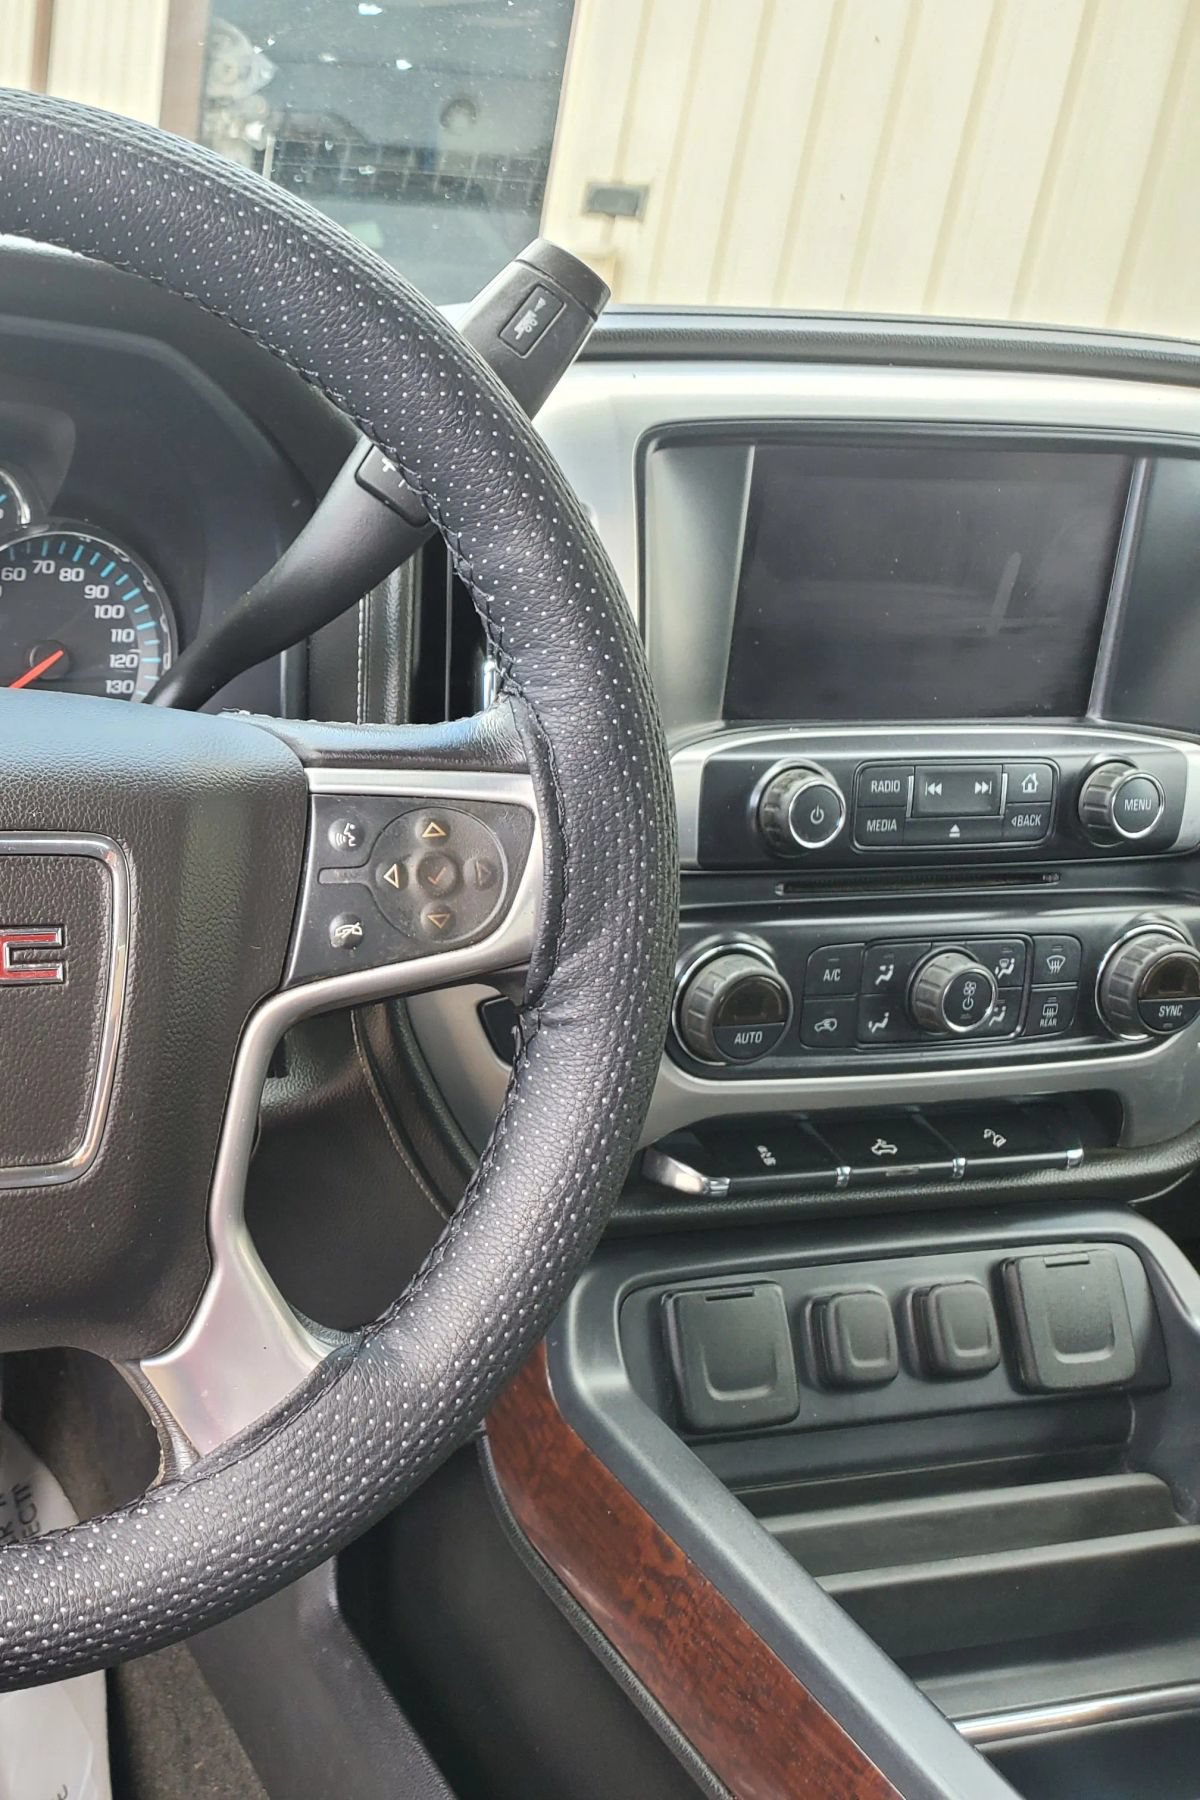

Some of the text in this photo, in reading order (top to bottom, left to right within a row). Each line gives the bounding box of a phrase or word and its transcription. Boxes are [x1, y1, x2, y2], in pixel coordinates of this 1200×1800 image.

[1, 567, 27, 581] 60
[32, 560, 55, 574] 70
[59, 567, 84, 582] 80
[84, 584, 109, 599] 90
[94, 604, 125, 619] 100
[110, 628, 135, 643] 110
[109, 654, 138, 669] 120
[105, 679, 135, 694] 130
[871, 780, 900, 793] RADIO
[1124, 798, 1152, 812] MENU
[866, 818, 897, 832] MEDIA
[1017, 814, 1042, 827] BACK
[823, 969, 841, 982] A/C
[1158, 1005, 1183, 1018] SYNC
[1040, 1018, 1057, 1027] REAR
[734, 1031, 763, 1045] AUTO
